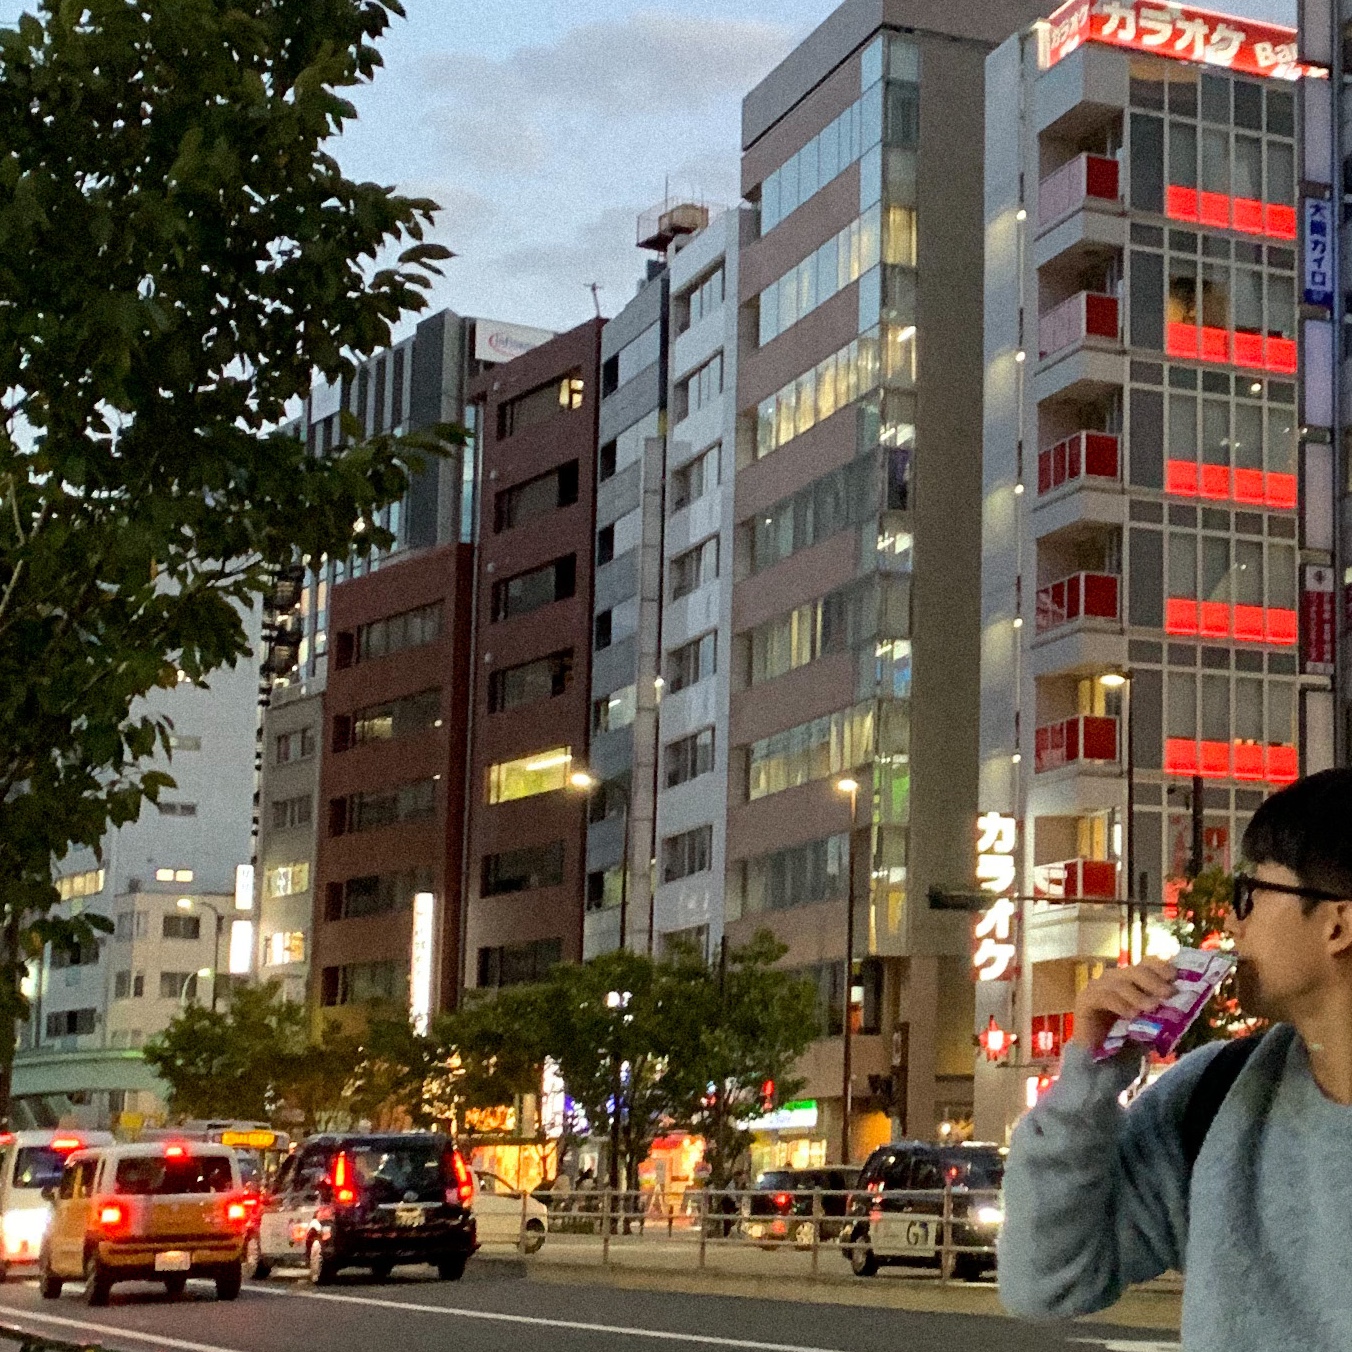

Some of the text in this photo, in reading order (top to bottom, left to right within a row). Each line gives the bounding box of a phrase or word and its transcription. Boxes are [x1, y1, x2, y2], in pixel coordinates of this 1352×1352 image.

[1101, 3, 1246, 66] カラオケ
[974, 811, 1016, 982] カラオケ
